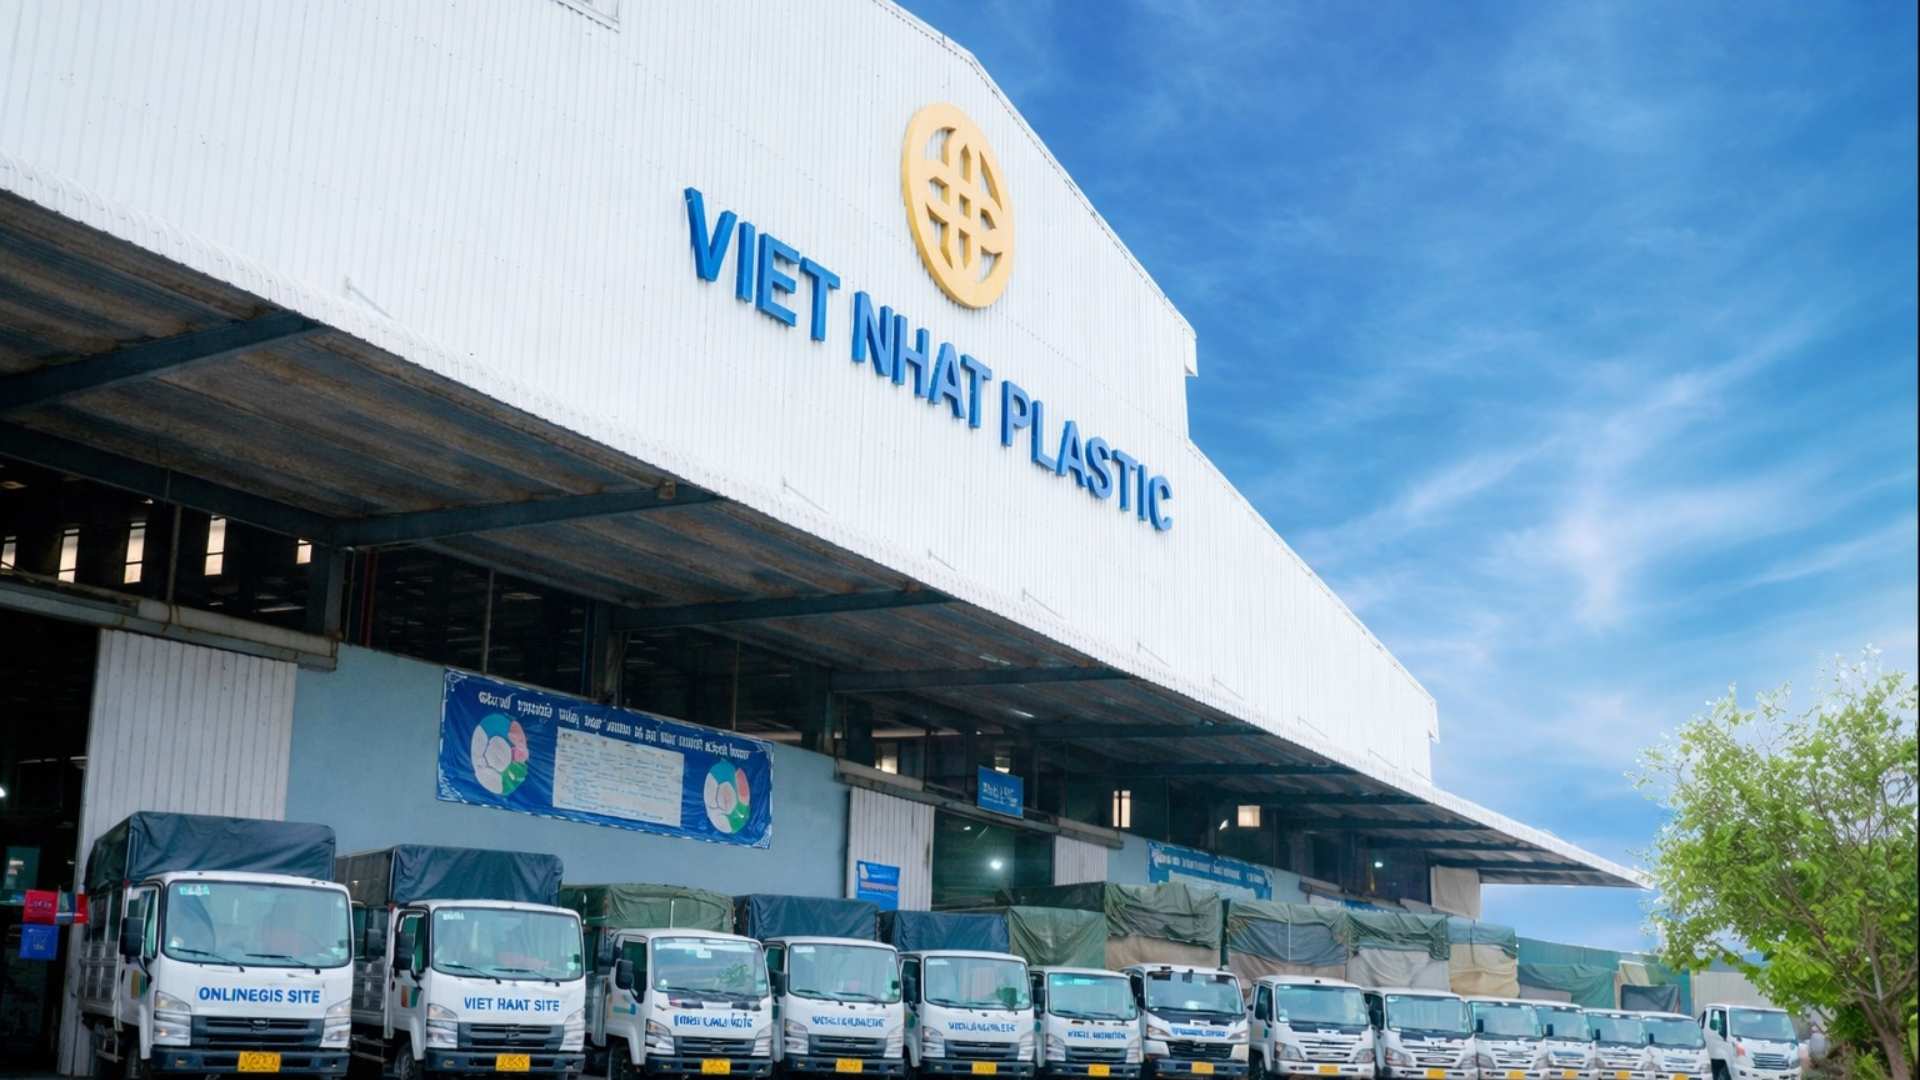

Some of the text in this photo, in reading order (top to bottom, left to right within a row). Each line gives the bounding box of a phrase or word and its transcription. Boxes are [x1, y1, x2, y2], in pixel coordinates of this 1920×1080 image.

[684, 187, 1173, 531] VIET NHAT PLASTIC
[199, 987, 320, 1003] ONLINEGIS SITE
[464, 996, 494, 1010] VIET
[534, 1000, 560, 1012] SITE
